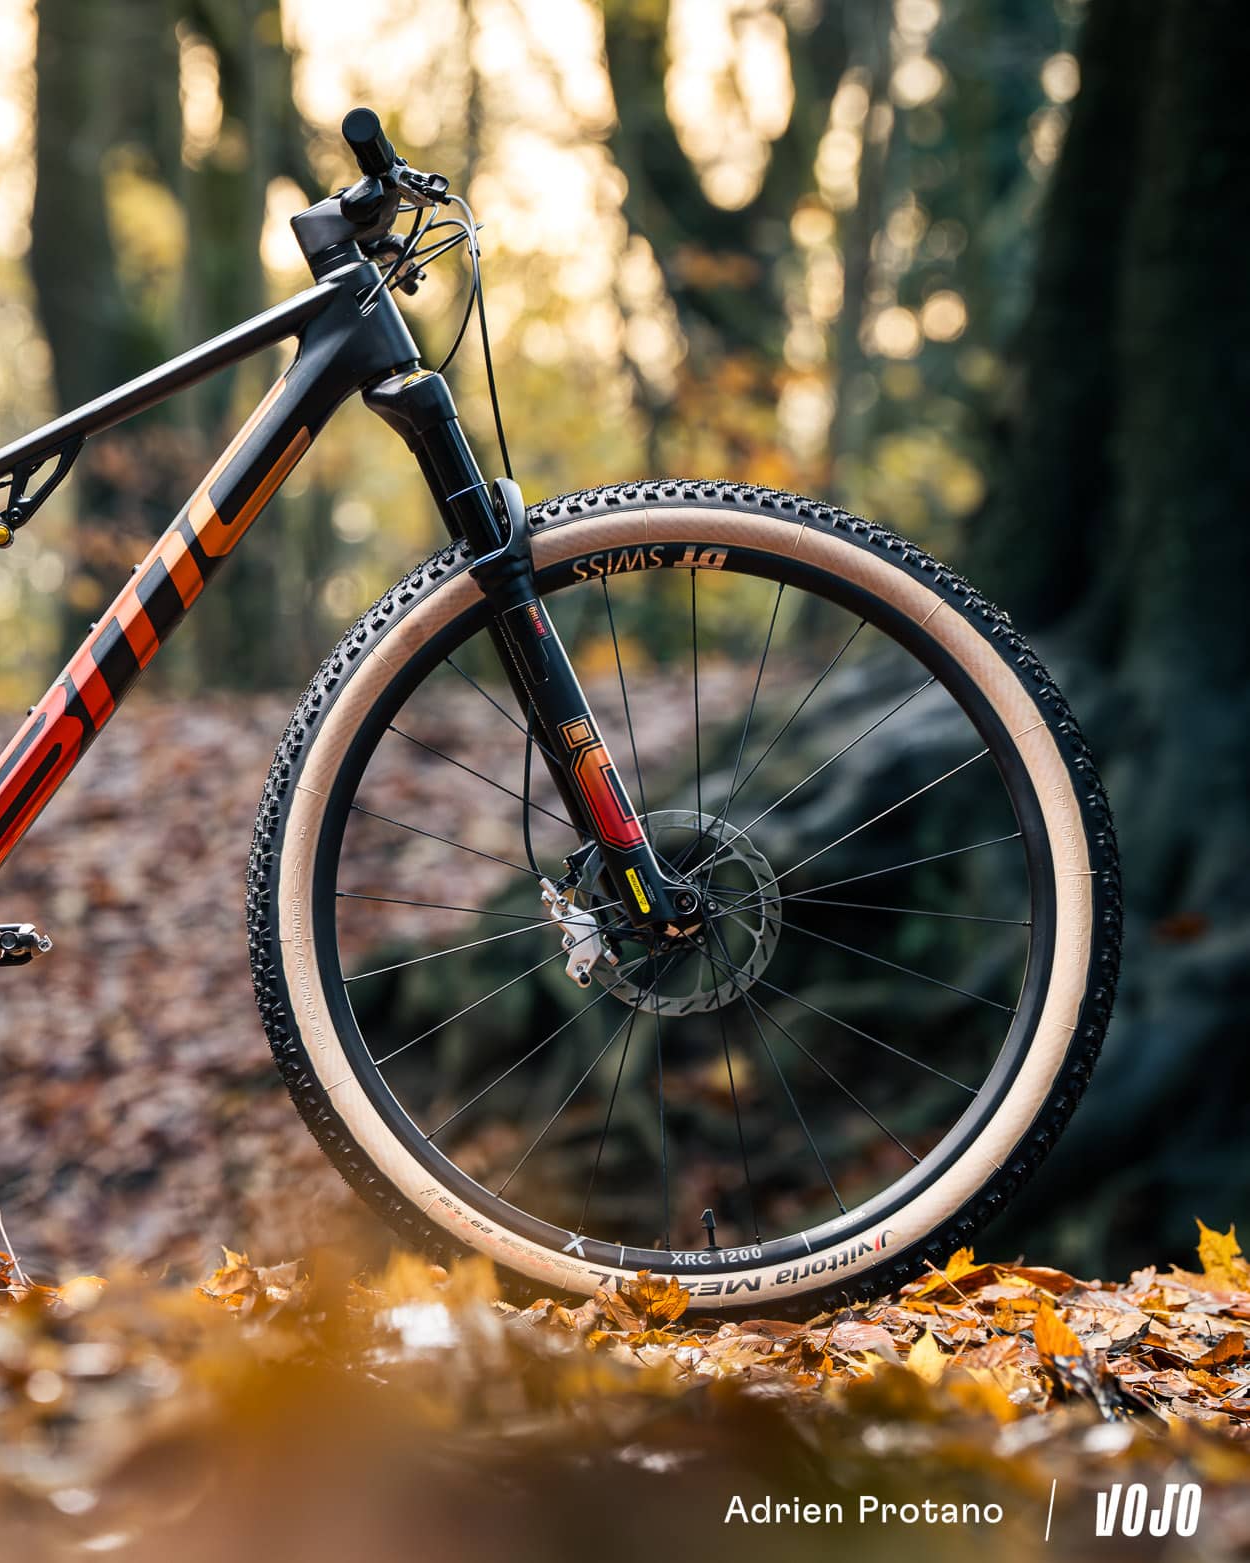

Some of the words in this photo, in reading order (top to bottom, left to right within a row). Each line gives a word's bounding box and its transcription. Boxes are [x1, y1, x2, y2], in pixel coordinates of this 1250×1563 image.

[572, 545, 665, 584] SWISS
[672, 545, 728, 570] DT
[670, 1251, 712, 1267] XRC
[717, 1246, 763, 1265] 1200
[775, 1241, 872, 1286] vittoria
[588, 1270, 761, 1297] MEZL
